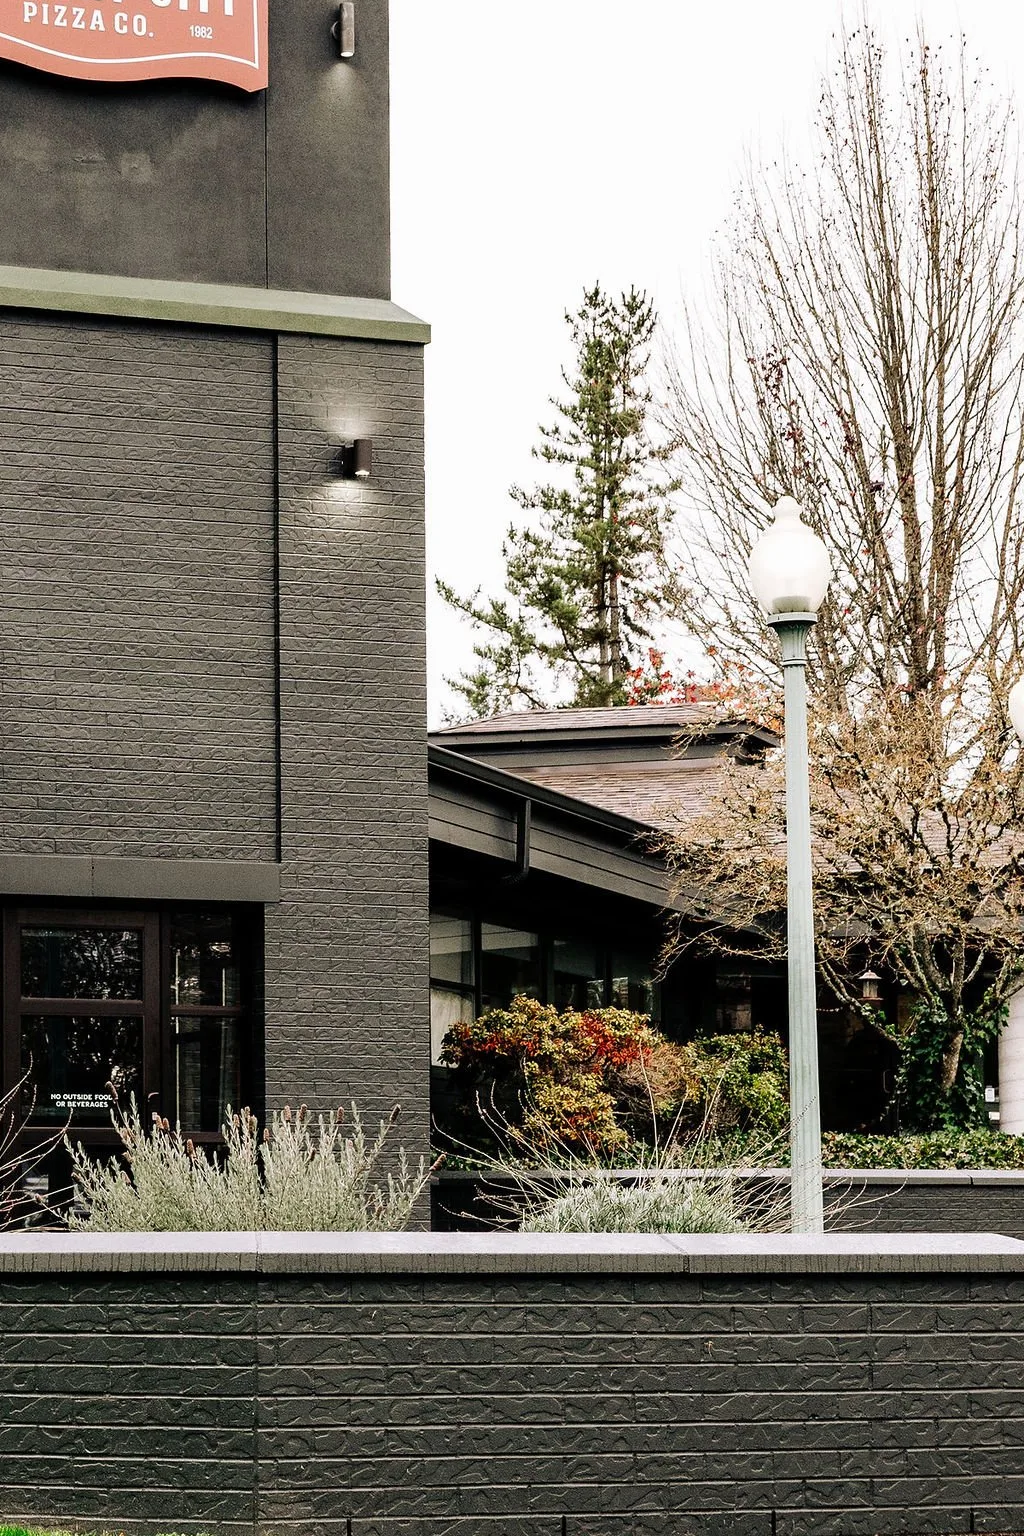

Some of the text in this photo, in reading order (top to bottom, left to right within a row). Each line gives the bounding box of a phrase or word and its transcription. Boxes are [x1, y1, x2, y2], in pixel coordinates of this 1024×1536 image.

[23, 1, 155, 38] PIZZA CO.
[189, 24, 214, 40] 1982
